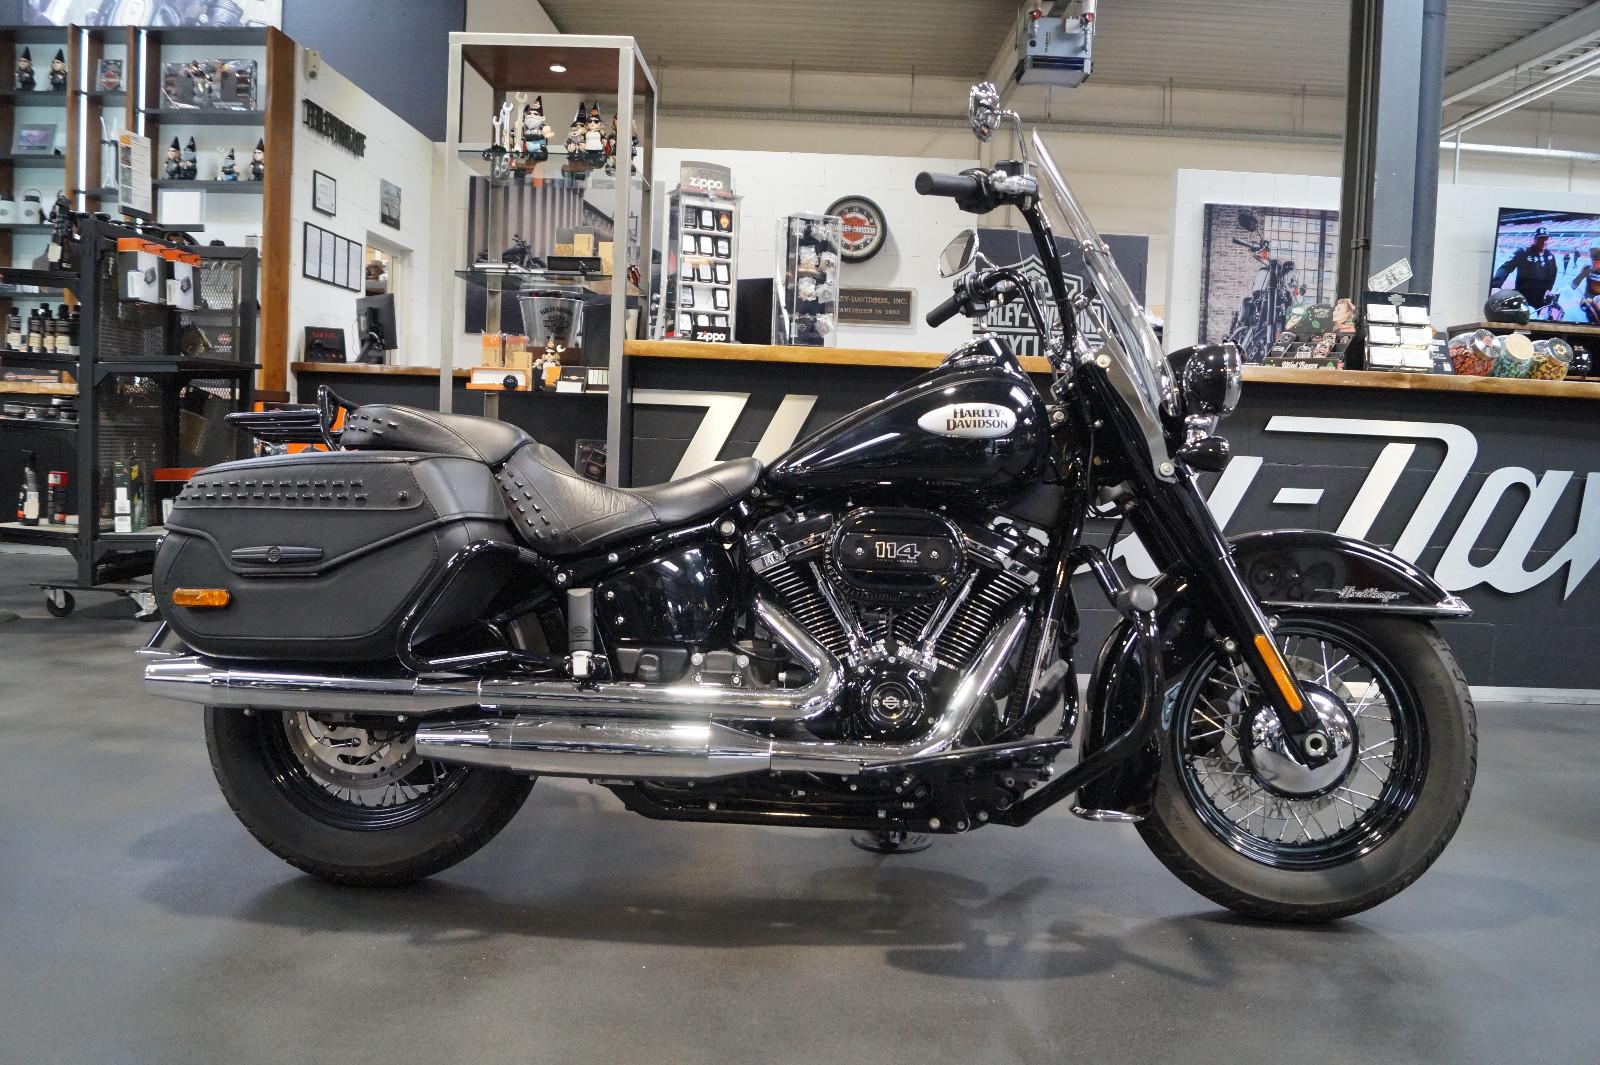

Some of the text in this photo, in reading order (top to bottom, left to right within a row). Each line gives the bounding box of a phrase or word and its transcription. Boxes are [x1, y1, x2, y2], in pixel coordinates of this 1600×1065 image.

[696, 329, 726, 342] zippo
[946, 419, 1008, 431] DAVIDSON
[875, 541, 922, 560] 114
